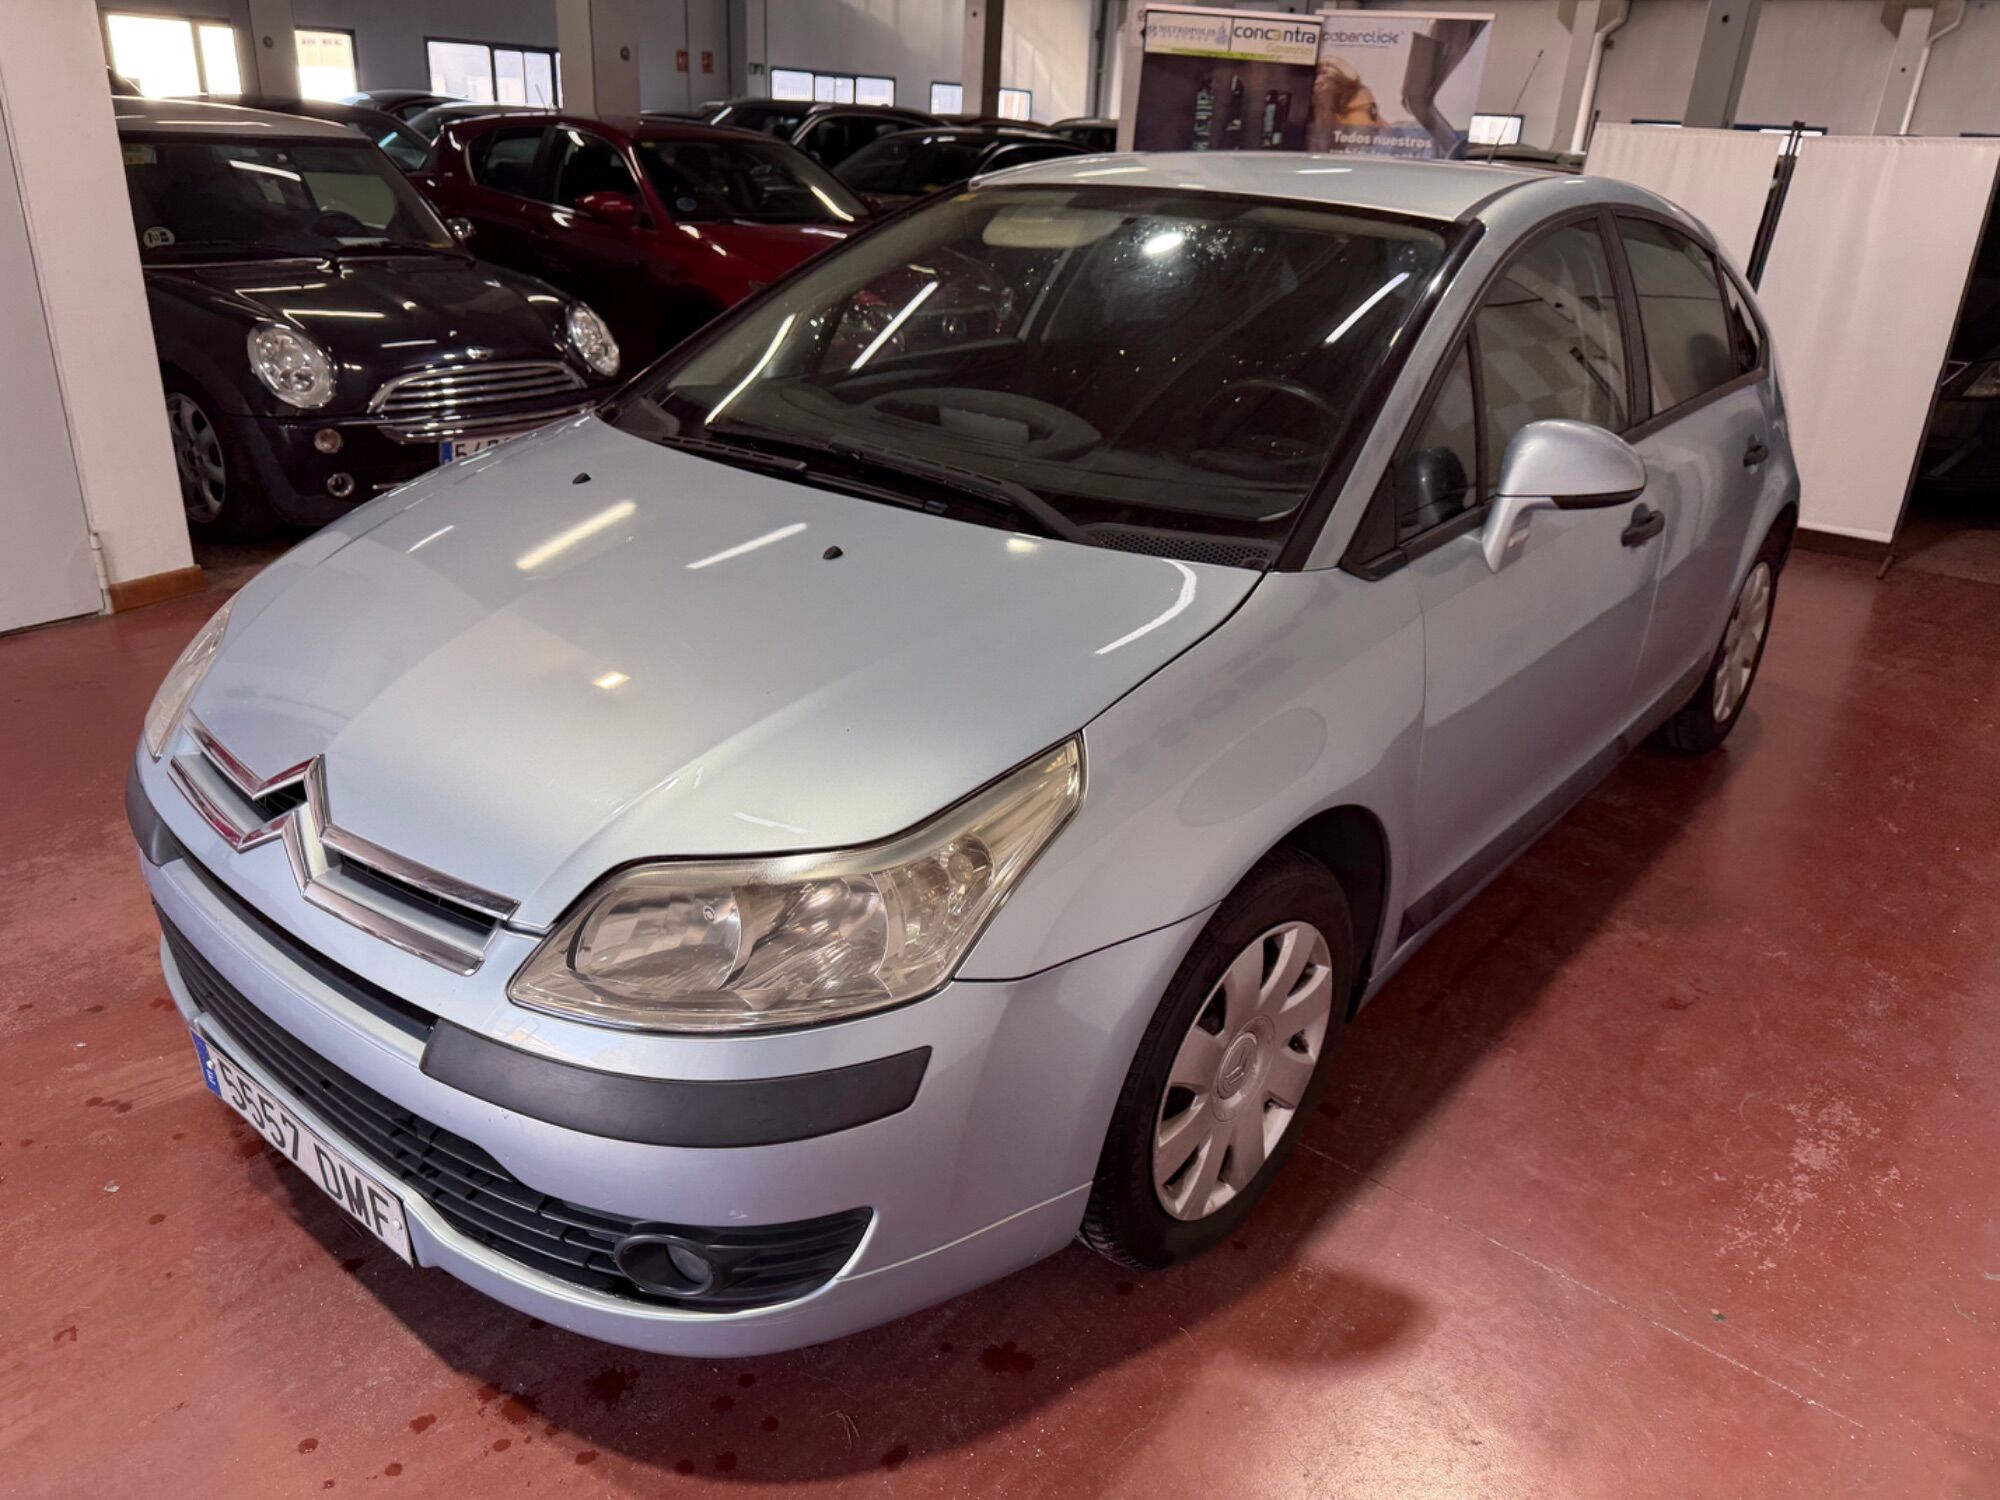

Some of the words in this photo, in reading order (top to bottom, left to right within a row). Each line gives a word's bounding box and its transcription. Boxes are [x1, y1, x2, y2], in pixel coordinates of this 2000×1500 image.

[1233, 25, 1316, 45] concentra
[1333, 130, 1371, 145] Todos
[1372, 135, 1432, 149] nuestros
[217, 1058, 299, 1161] 5557
[314, 1143, 390, 1237] DMF
